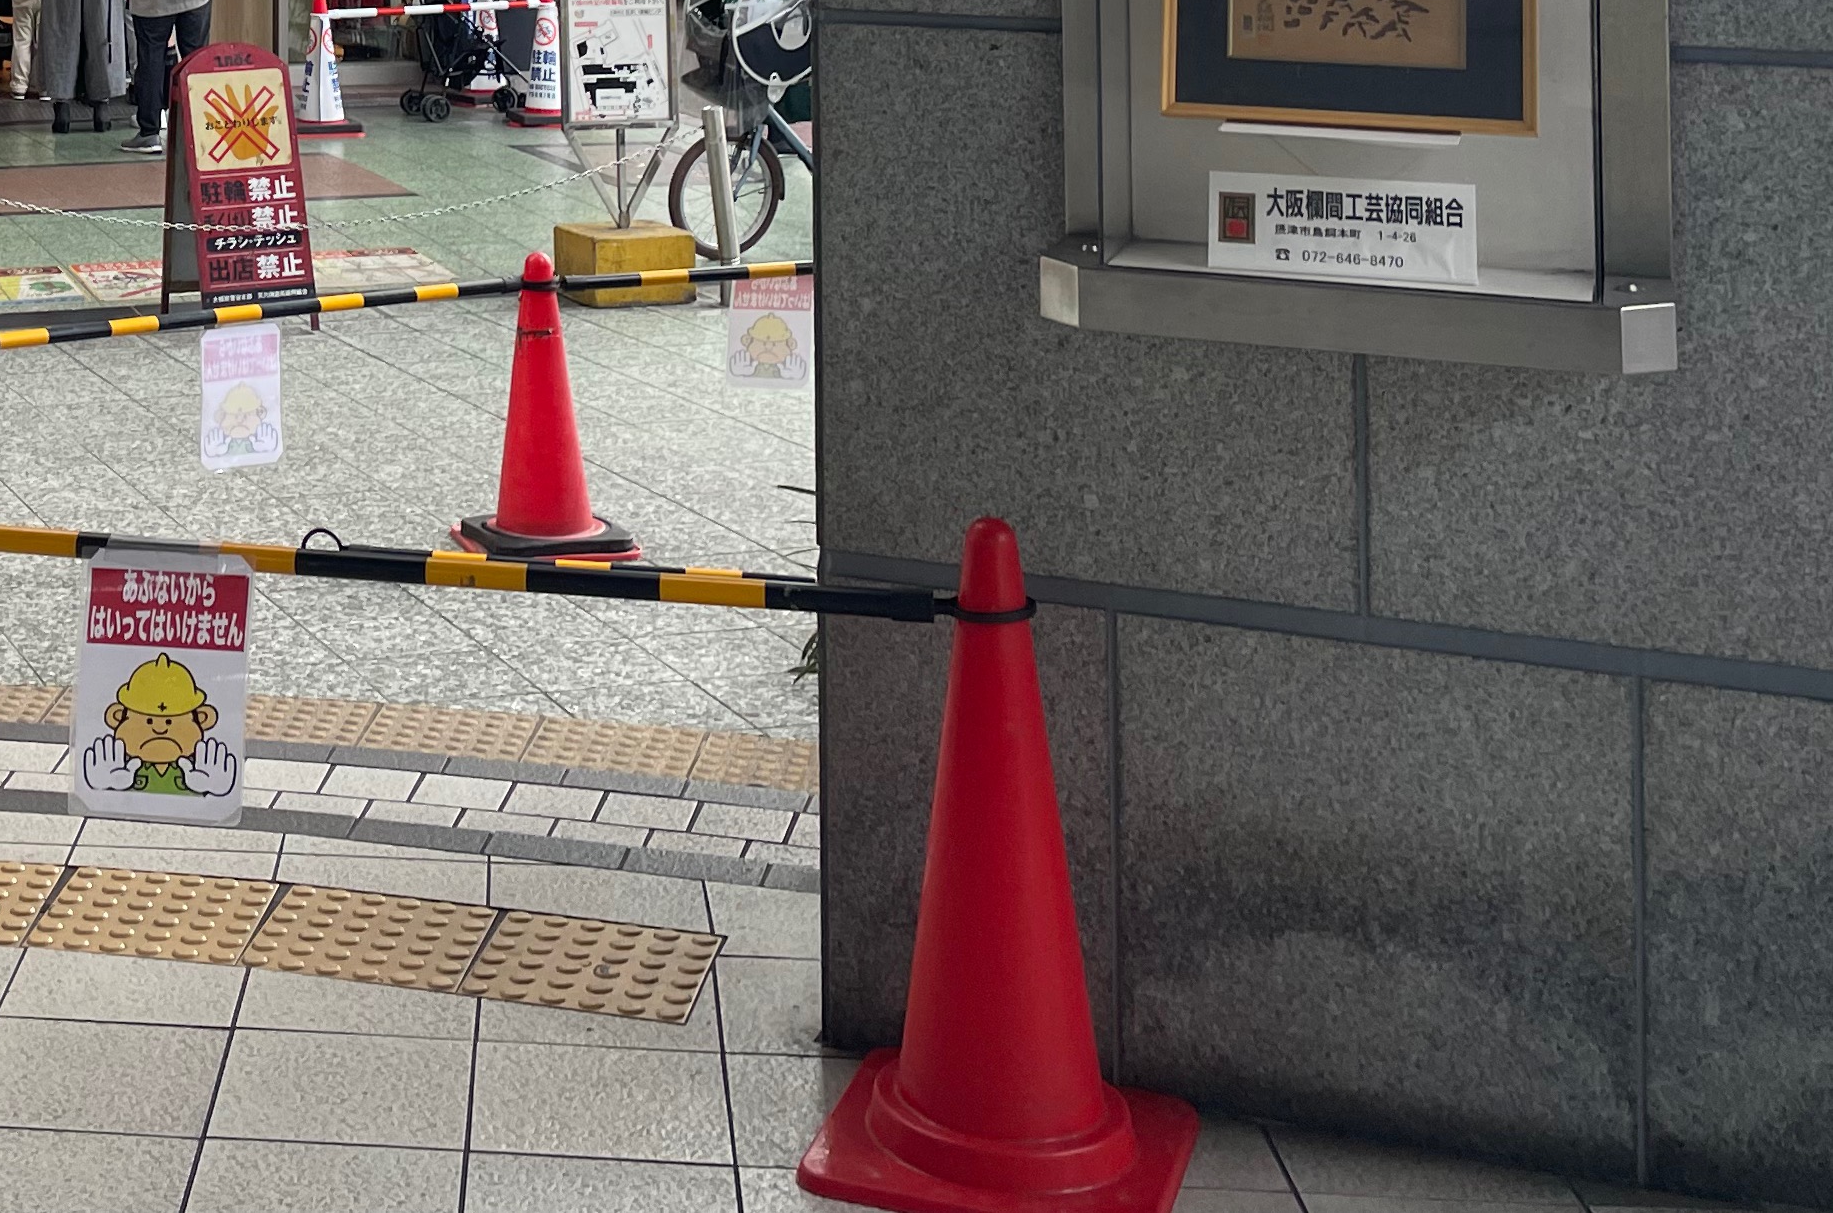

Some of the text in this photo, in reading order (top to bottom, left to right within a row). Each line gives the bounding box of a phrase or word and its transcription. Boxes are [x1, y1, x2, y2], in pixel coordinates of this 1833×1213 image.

[200, 174, 297, 204] 駐輪禁止
[1266, 187, 1464, 229] 大阪欄間工芸協同組合
[209, 251, 306, 283] 出店禁止
[1301, 249, 1404, 268] 072-646-8470
[122, 568, 217, 608] あぶないから
[89, 605, 244, 648] はいってはいけません
